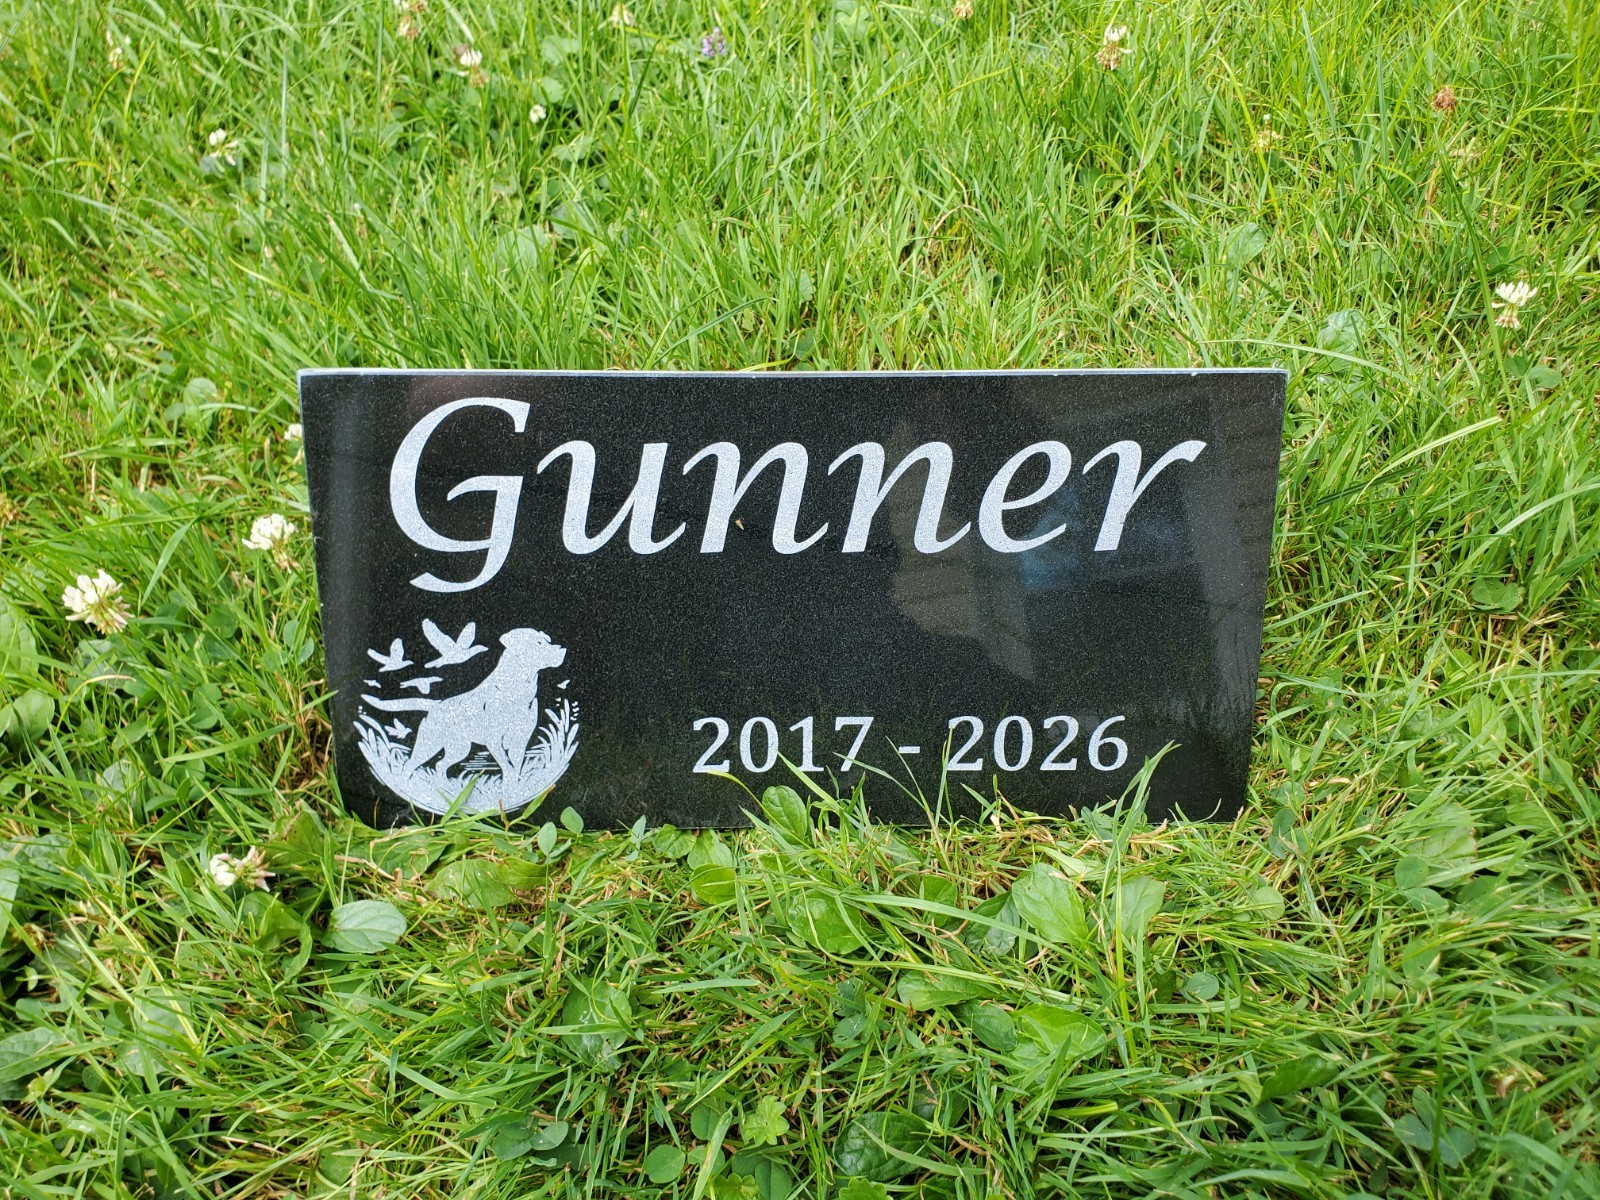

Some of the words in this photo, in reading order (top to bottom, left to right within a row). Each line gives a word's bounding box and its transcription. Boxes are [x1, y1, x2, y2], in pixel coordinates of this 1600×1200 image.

[389, 396, 1208, 593] Gunner
[692, 715, 874, 774] 2017
[898, 746, 921, 754] -
[946, 715, 1129, 772] 2026
